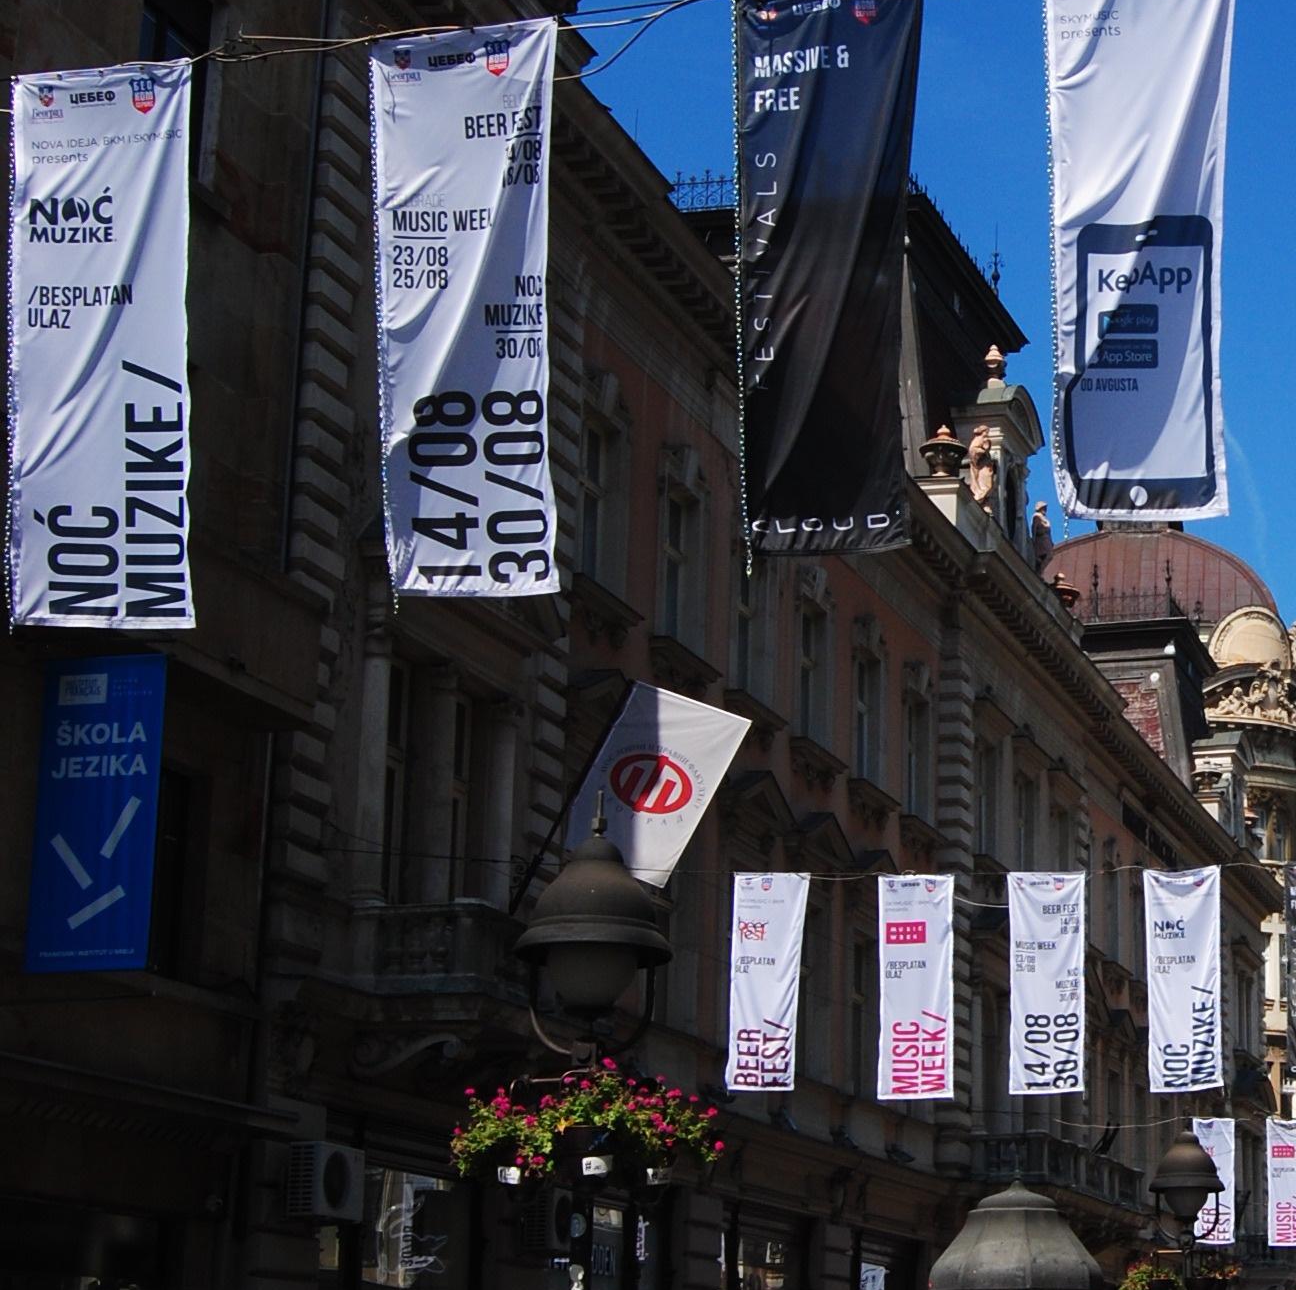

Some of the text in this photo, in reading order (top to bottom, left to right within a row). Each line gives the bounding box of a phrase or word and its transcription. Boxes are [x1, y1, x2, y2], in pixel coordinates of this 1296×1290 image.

[1061, 25, 1121, 40] presents
[428, 52, 477, 68] ЦЕБЕФ
[754, 44, 850, 78] MASSIVE &
[70, 90, 116, 105] ЦЕБЕФ
[754, 87, 801, 113] FREE
[465, 113, 507, 139] BEER
[32, 139, 63, 150] NOVA
[32, 152, 89, 166] presents
[392, 210, 448, 233] MUSIC
[29, 226, 114, 244] MUZIKE
[393, 245, 449, 267] 23/08
[393, 268, 449, 290] 25/08
[27, 284, 133, 307] /BESPLATAN
[28, 308, 71, 329] ULAZ
[484, 303, 543, 326] MUZIKE
[1125, 350, 1153, 363] Store
[1096, 377, 1140, 392] AVGUSTA
[408, 390, 482, 585] 14/08
[481, 389, 551, 585] 30/08
[35, 504, 120, 617] NOĆ
[55, 719, 148, 747] ŠKOLA
[51, 753, 148, 780] JEZIKA
[734, 1028, 762, 1087] BEER
[891, 1021, 921, 1095] MUSIC
[1024, 1013, 1051, 1091] 14/08
[1053, 1012, 1080, 1090] 30/08
[1156, 1043, 1190, 1089] NOĆ
[1275, 1201, 1292, 1244] MUSIC
